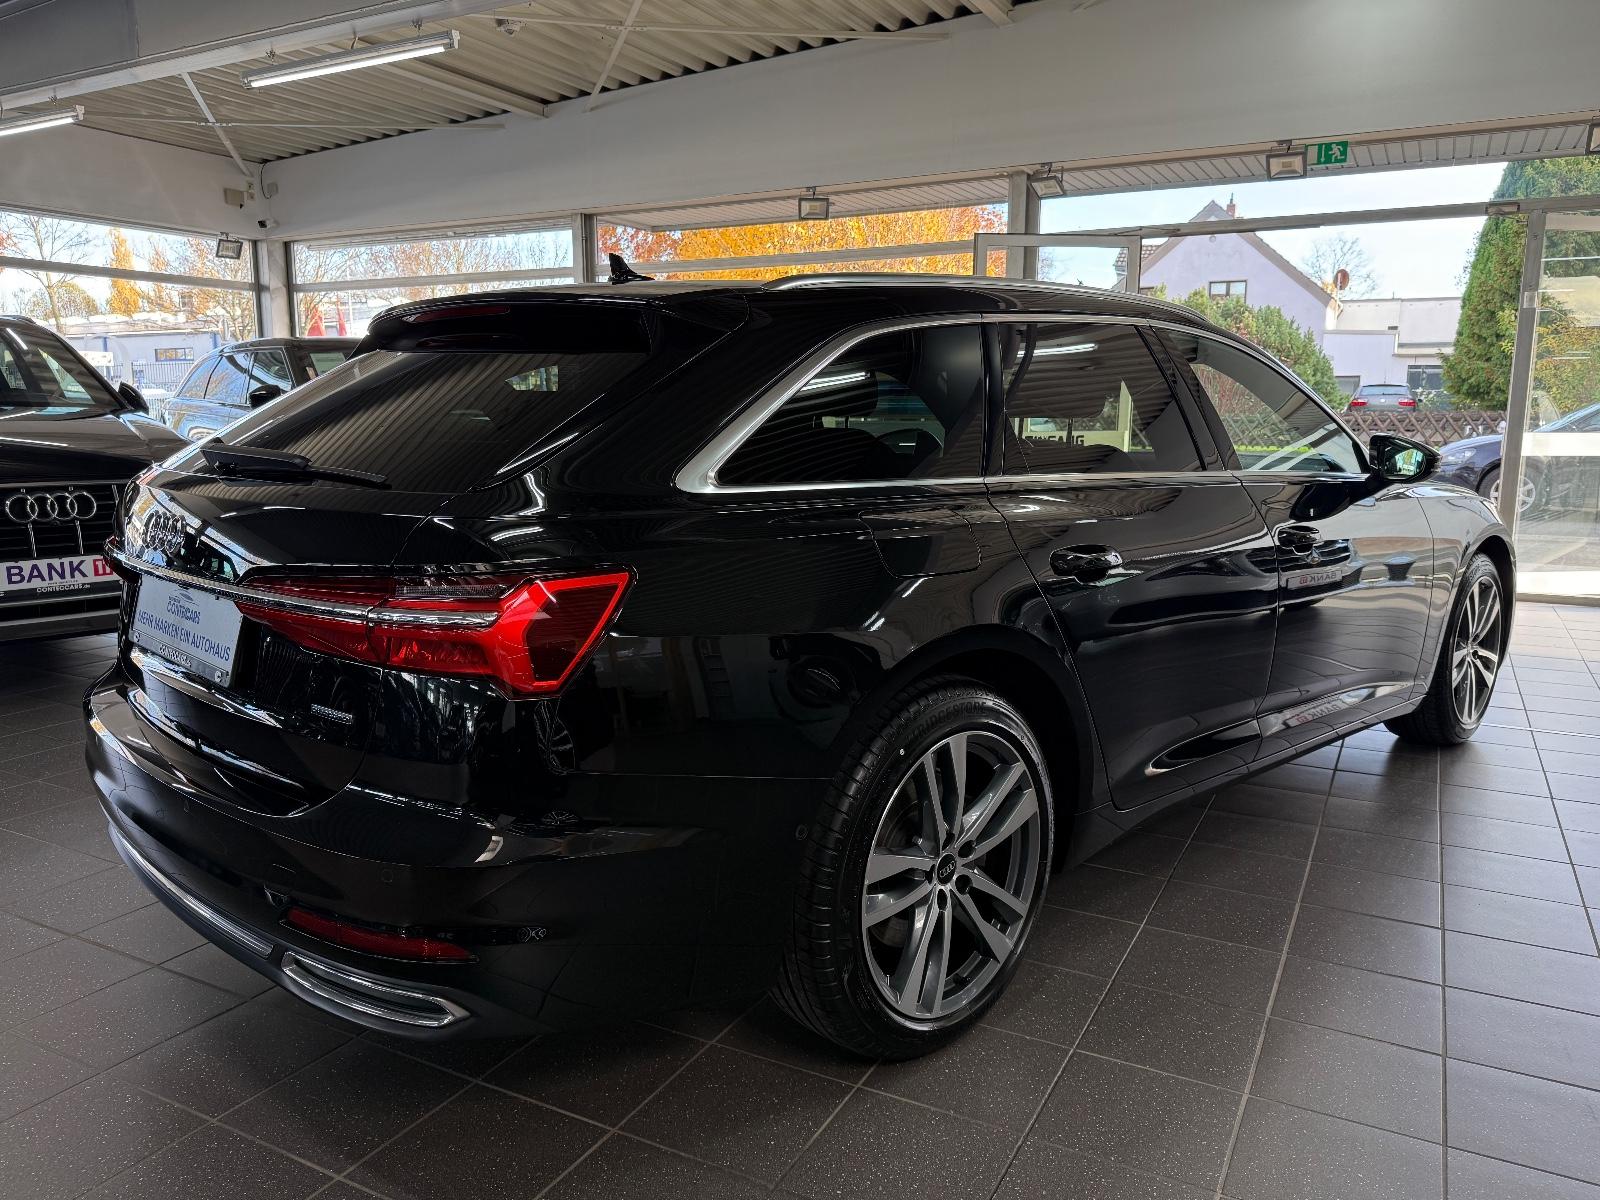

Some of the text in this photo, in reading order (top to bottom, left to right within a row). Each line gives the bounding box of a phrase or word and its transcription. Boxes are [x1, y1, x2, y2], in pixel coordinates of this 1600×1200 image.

[6, 560, 88, 585] BANK
[138, 610, 231, 661] MEHR MARKEN EIN AUTOHAUS
